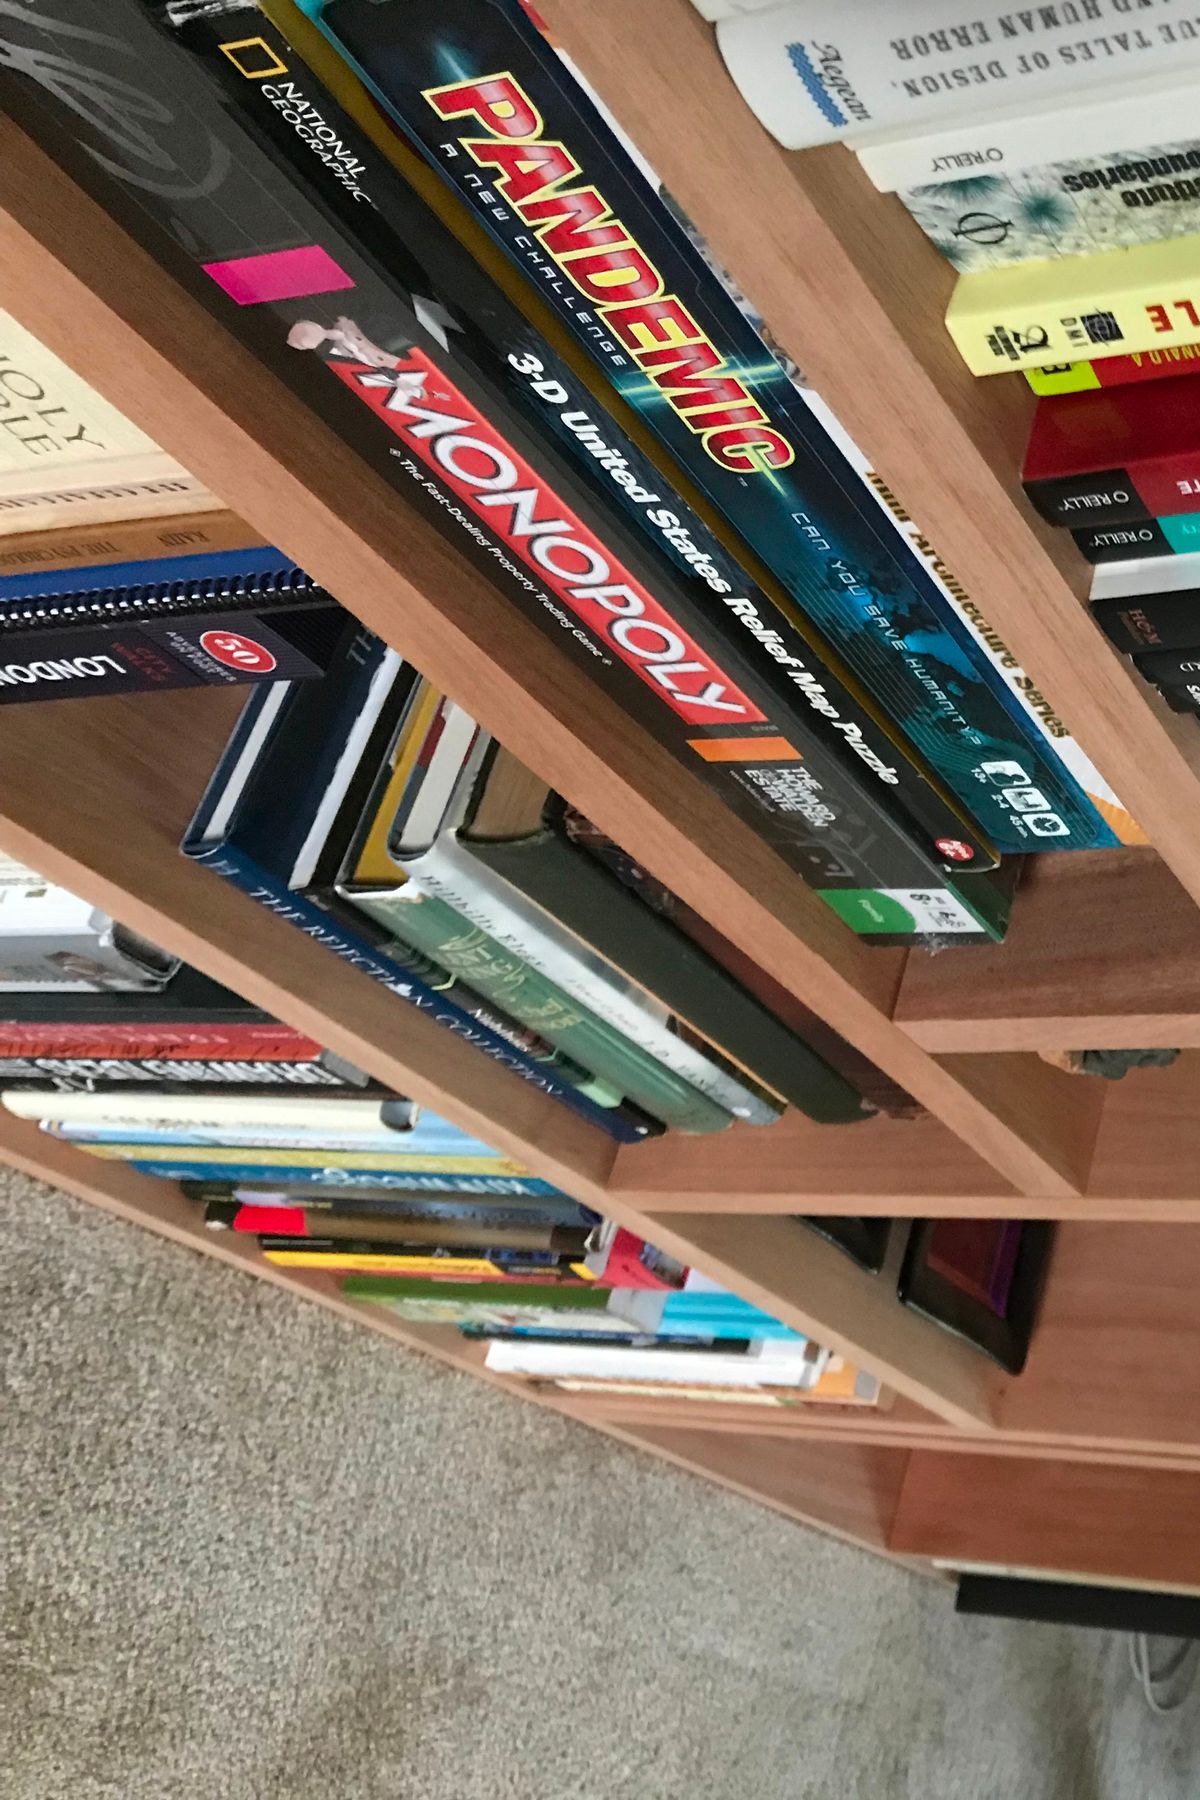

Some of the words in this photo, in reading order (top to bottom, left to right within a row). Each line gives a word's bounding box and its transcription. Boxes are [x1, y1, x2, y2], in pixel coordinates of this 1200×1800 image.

[1003, 0, 1100, 37] HUMAN
[890, 19, 999, 62] ERROR
[1057, 30, 1151, 67] TALES
[1016, 51, 1050, 74] OF
[261, 84, 372, 205] GEOGRAPHIC
[277, 81, 368, 178] NATIONAL
[931, 147, 1003, 172] O'REILLY
[421, 71, 797, 474] PANDEMIC
[439, 143, 460, 158] A
[465, 174, 510, 222] NEW
[514, 234, 627, 367] CHALLENGE
[352, 370, 748, 715] MONOPOLY
[400, 458, 423, 480] The
[421, 481, 490, 548] Fast-Dealing
[488, 547, 537, 593] Property
[535, 592, 575, 630] Trading
[572, 628, 603, 657] Game
[1088, 529, 1153, 548] O'REILLY
[506, 351, 569, 404] 3-D
[560, 410, 652, 504] United
[647, 508, 731, 594] States
[723, 597, 804, 675] Relief
[789, 666, 839, 720] Map
[833, 720, 899, 785] Puzzle
[792, 512, 830, 551] CAN
[829, 559, 867, 597] YOU
[864, 604, 907, 651] SAVE
[905, 658, 981, 747] HUMANITY?
[0, 655, 127, 687] LONDON
[214, 637, 262, 667] 50
[746, 770, 798, 811] ESTATE
[778, 769, 836, 821] HOWARD
[794, 767, 822, 791] THE
[250, 886, 303, 922] THE
